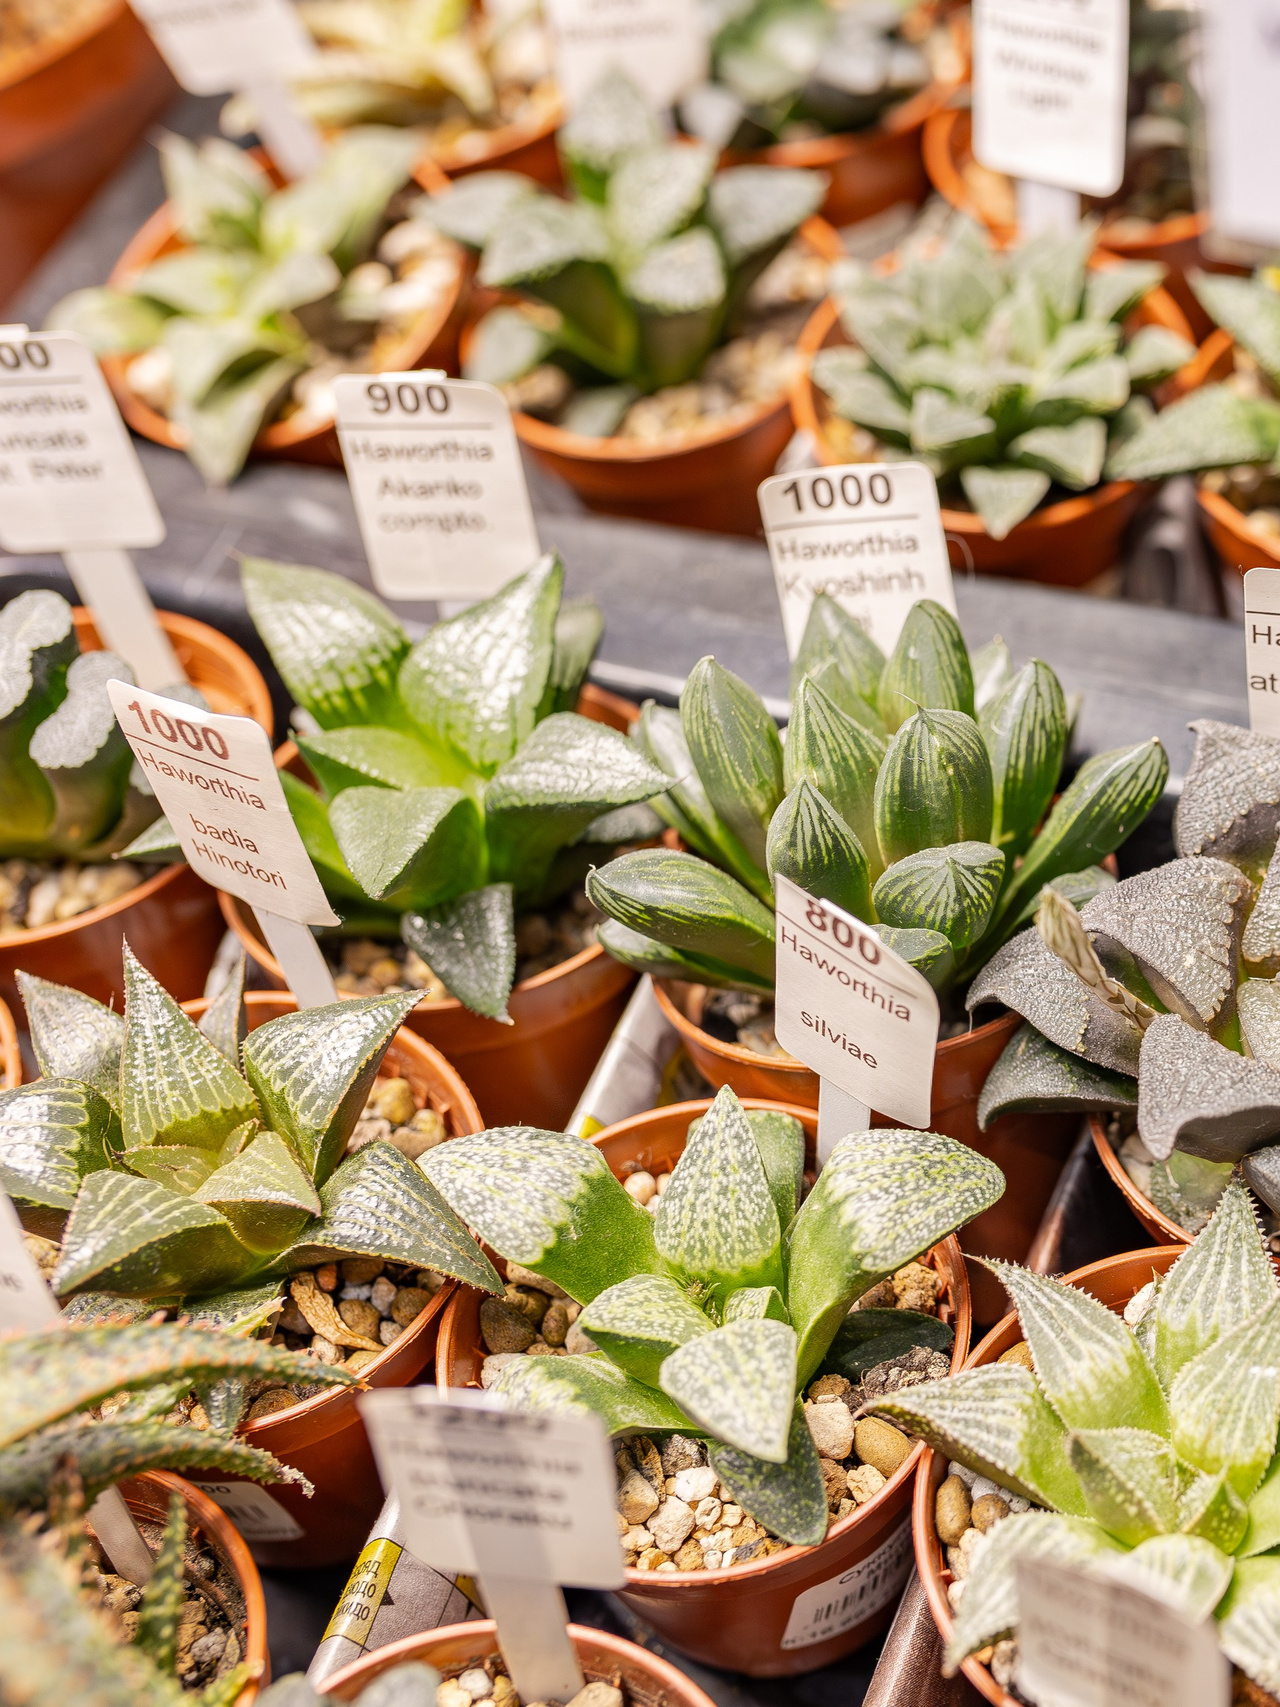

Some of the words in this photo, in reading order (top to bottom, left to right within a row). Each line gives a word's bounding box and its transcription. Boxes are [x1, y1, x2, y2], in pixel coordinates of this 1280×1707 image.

[366, 383, 450, 415] 900
[352, 437, 494, 463] Haworthia
[782, 473, 893, 512] 1000
[777, 533, 919, 561] Haworthia
[128, 699, 230, 760] 1000
[137, 748, 267, 811] Haworthia
[189, 813, 260, 855] badia
[192, 838, 288, 891] Hinotori
[806, 899, 881, 965] 800
[782, 926, 910, 1022] Haworthia
[801, 1010, 878, 1069] silviae
